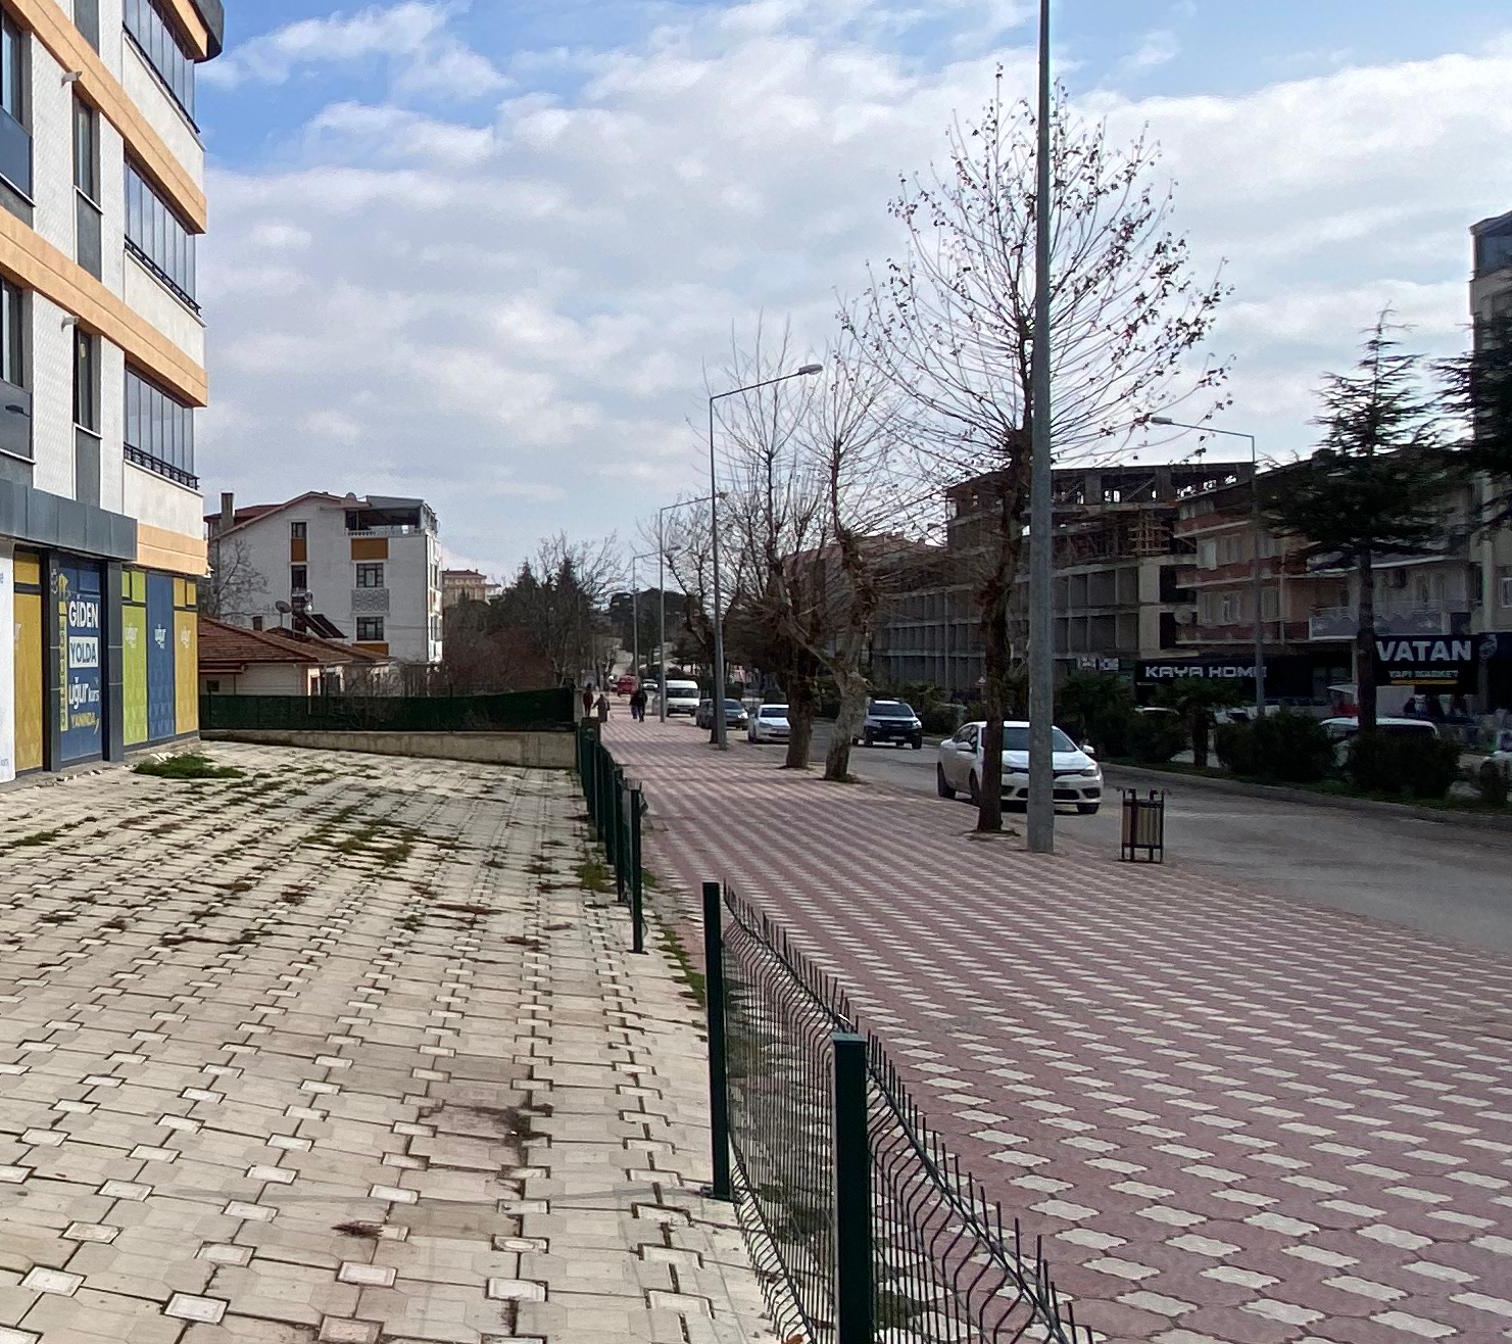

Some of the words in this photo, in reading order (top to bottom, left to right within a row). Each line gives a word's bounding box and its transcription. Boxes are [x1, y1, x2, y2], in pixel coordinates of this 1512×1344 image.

[69, 595, 98, 628] GİDEN
[70, 642, 97, 665] YOLDA
[1375, 639, 1472, 662] VATAN
[1144, 666, 1204, 678] KAYA
[68, 676, 90, 710] uğur
